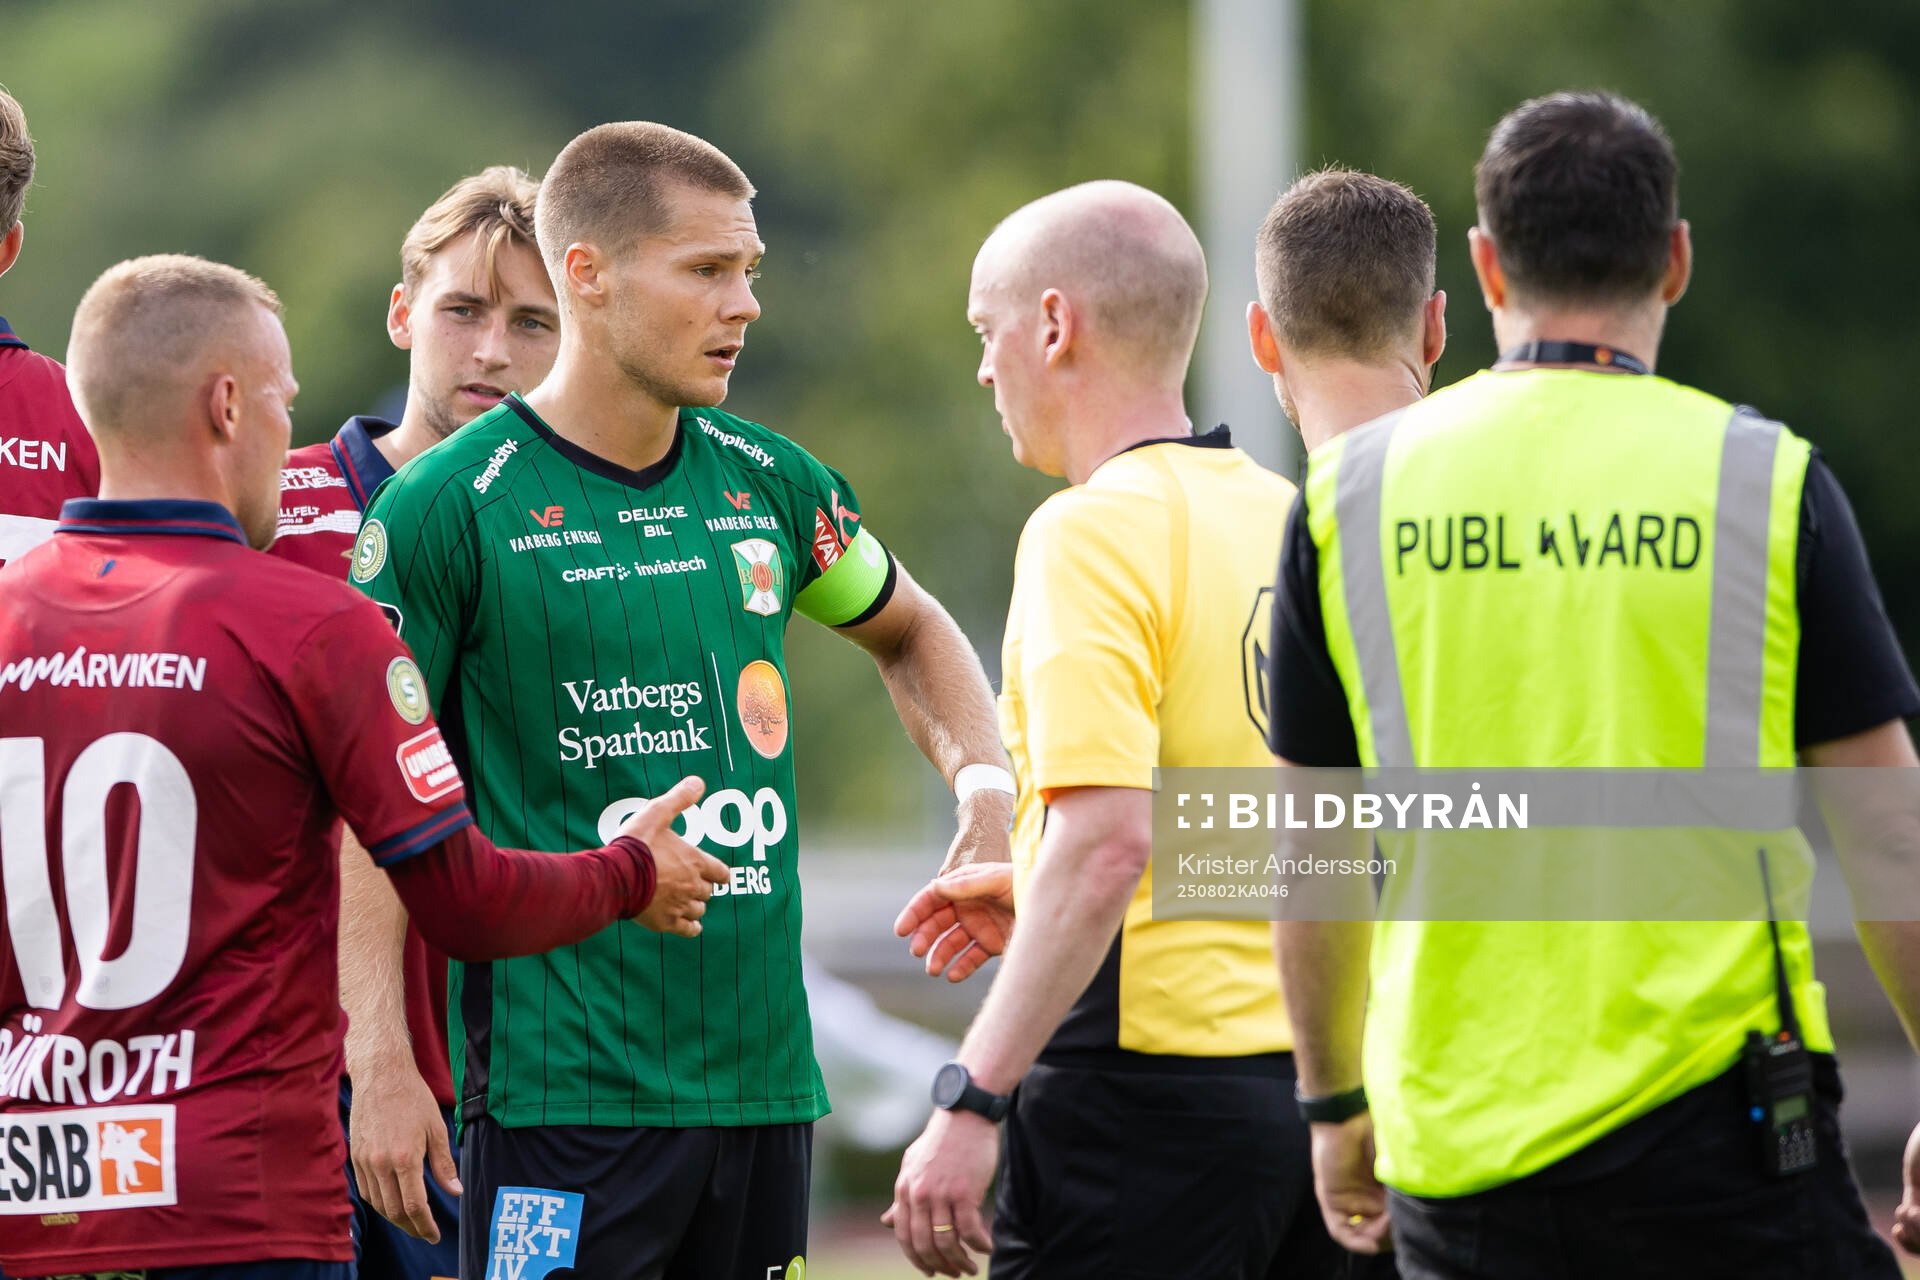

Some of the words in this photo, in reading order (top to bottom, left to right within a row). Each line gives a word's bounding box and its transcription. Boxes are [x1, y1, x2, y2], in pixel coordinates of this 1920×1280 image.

[618, 506, 688, 523] DELUXE
[705, 516, 752, 532] VARBERG
[509, 531, 562, 553] VARBERG
[563, 530, 602, 546] ENERGI
[643, 525, 672, 537] BIL
[562, 566, 616, 582] CRAFT
[634, 555, 707, 577] inviatech
[562, 677, 702, 716] Varbergs
[558, 719, 712, 769] Sparbank
[0, 732, 197, 1010] 10
[498, 1193, 565, 1226] EFF
[494, 1222, 571, 1258] EKT
